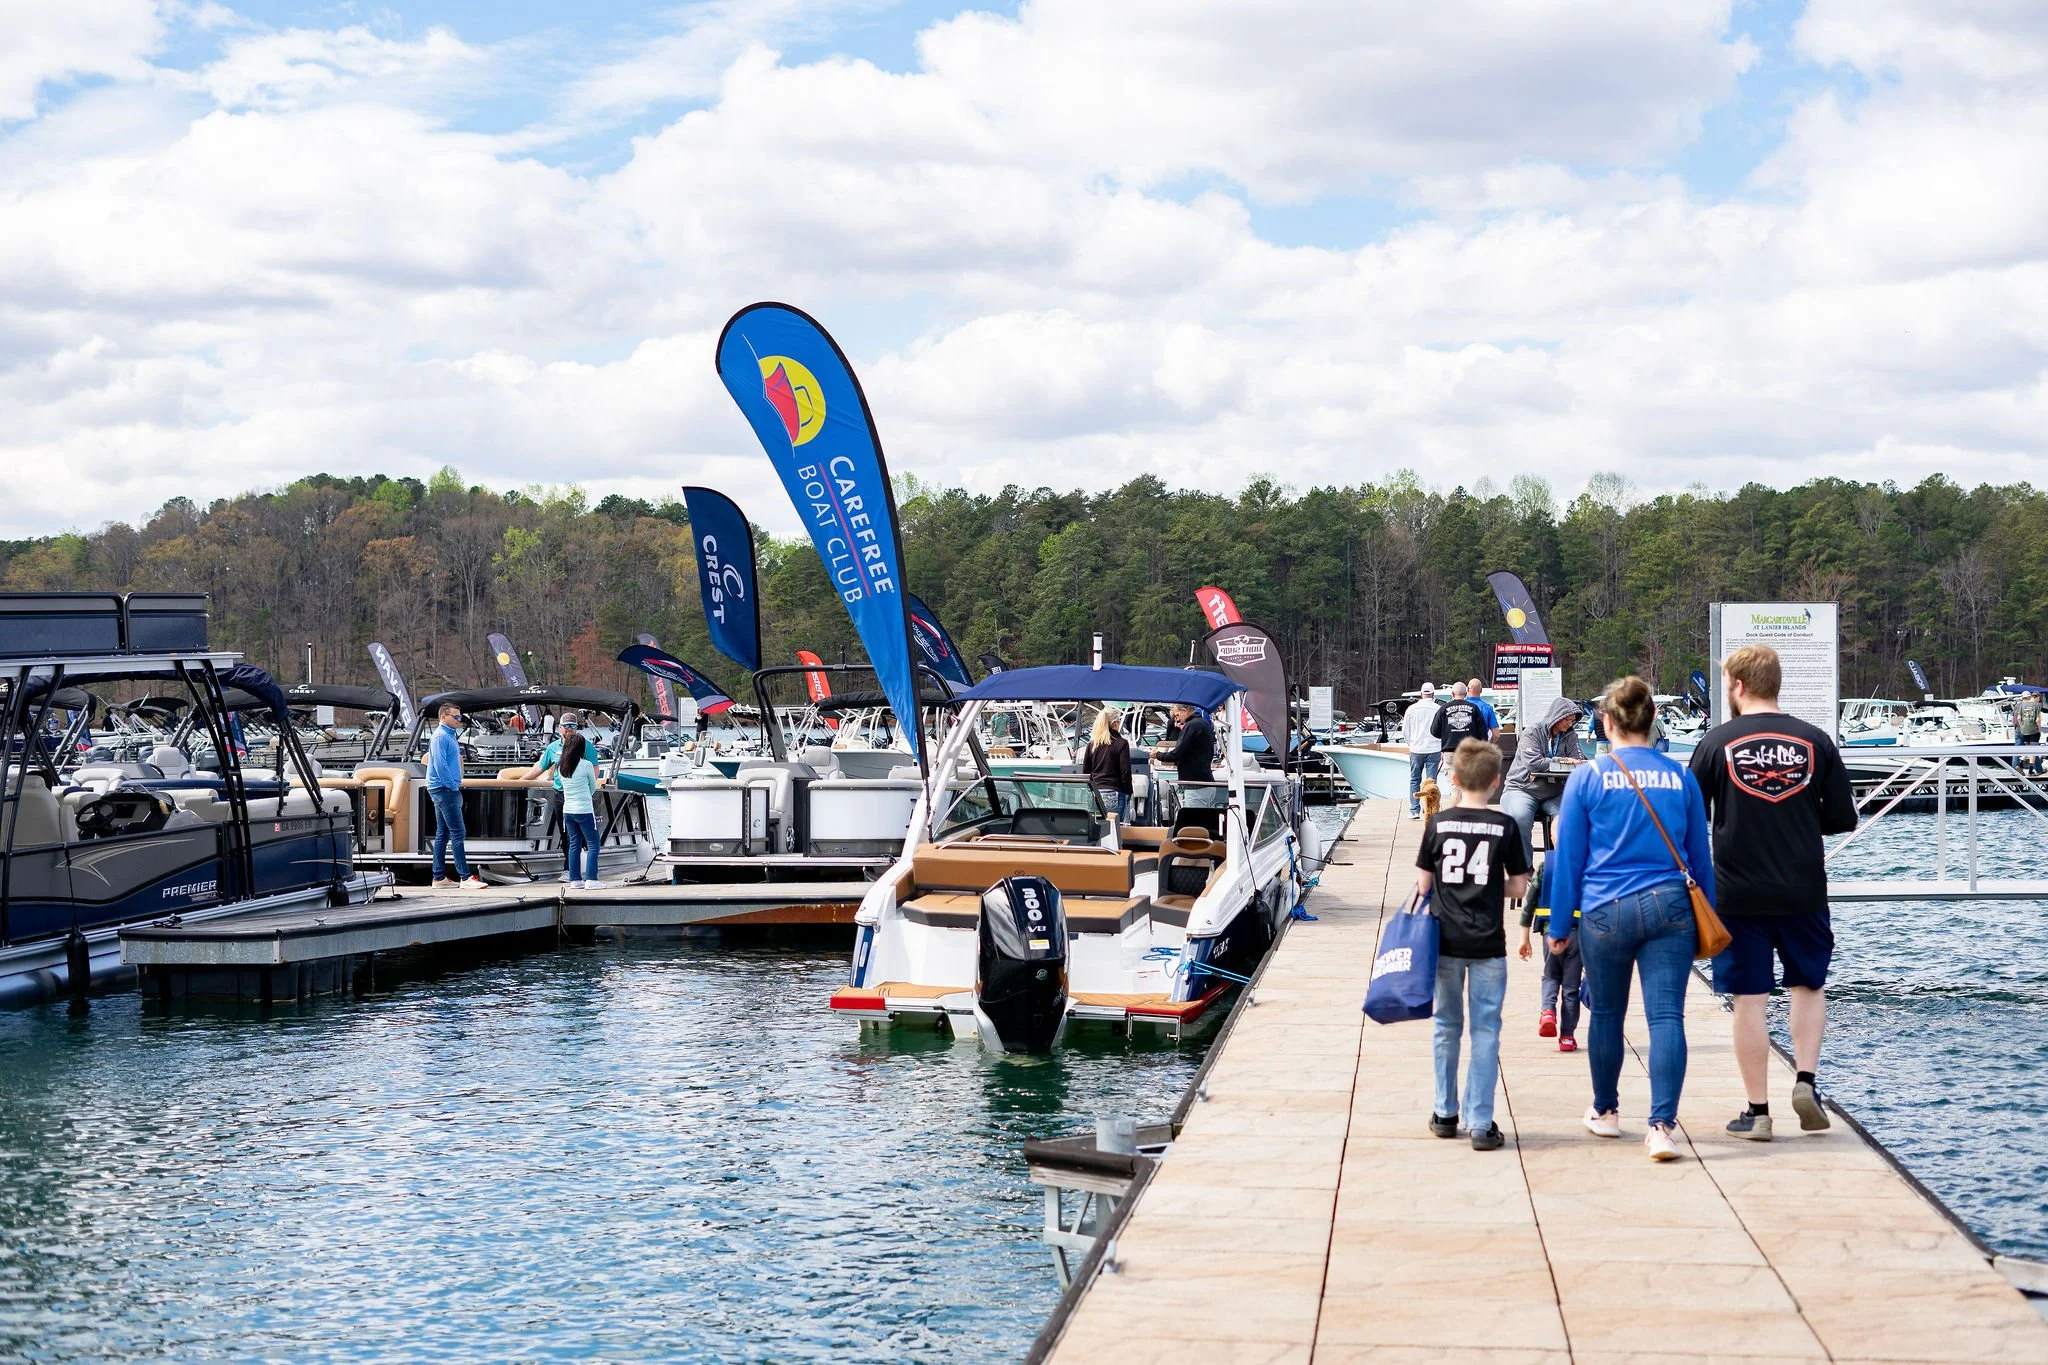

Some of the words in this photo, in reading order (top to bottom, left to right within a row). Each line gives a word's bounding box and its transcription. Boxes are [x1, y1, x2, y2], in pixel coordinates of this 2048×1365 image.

[798, 465, 838, 528] BOAT
[827, 537, 863, 604] CLUB
[829, 455, 893, 594] CAREFREE
[702, 535, 725, 625] CREST
[1442, 838, 1489, 886] 24
[162, 880, 217, 899] PREMIER
[1022, 887, 1043, 921] 300
[1027, 925, 1047, 933] V8
